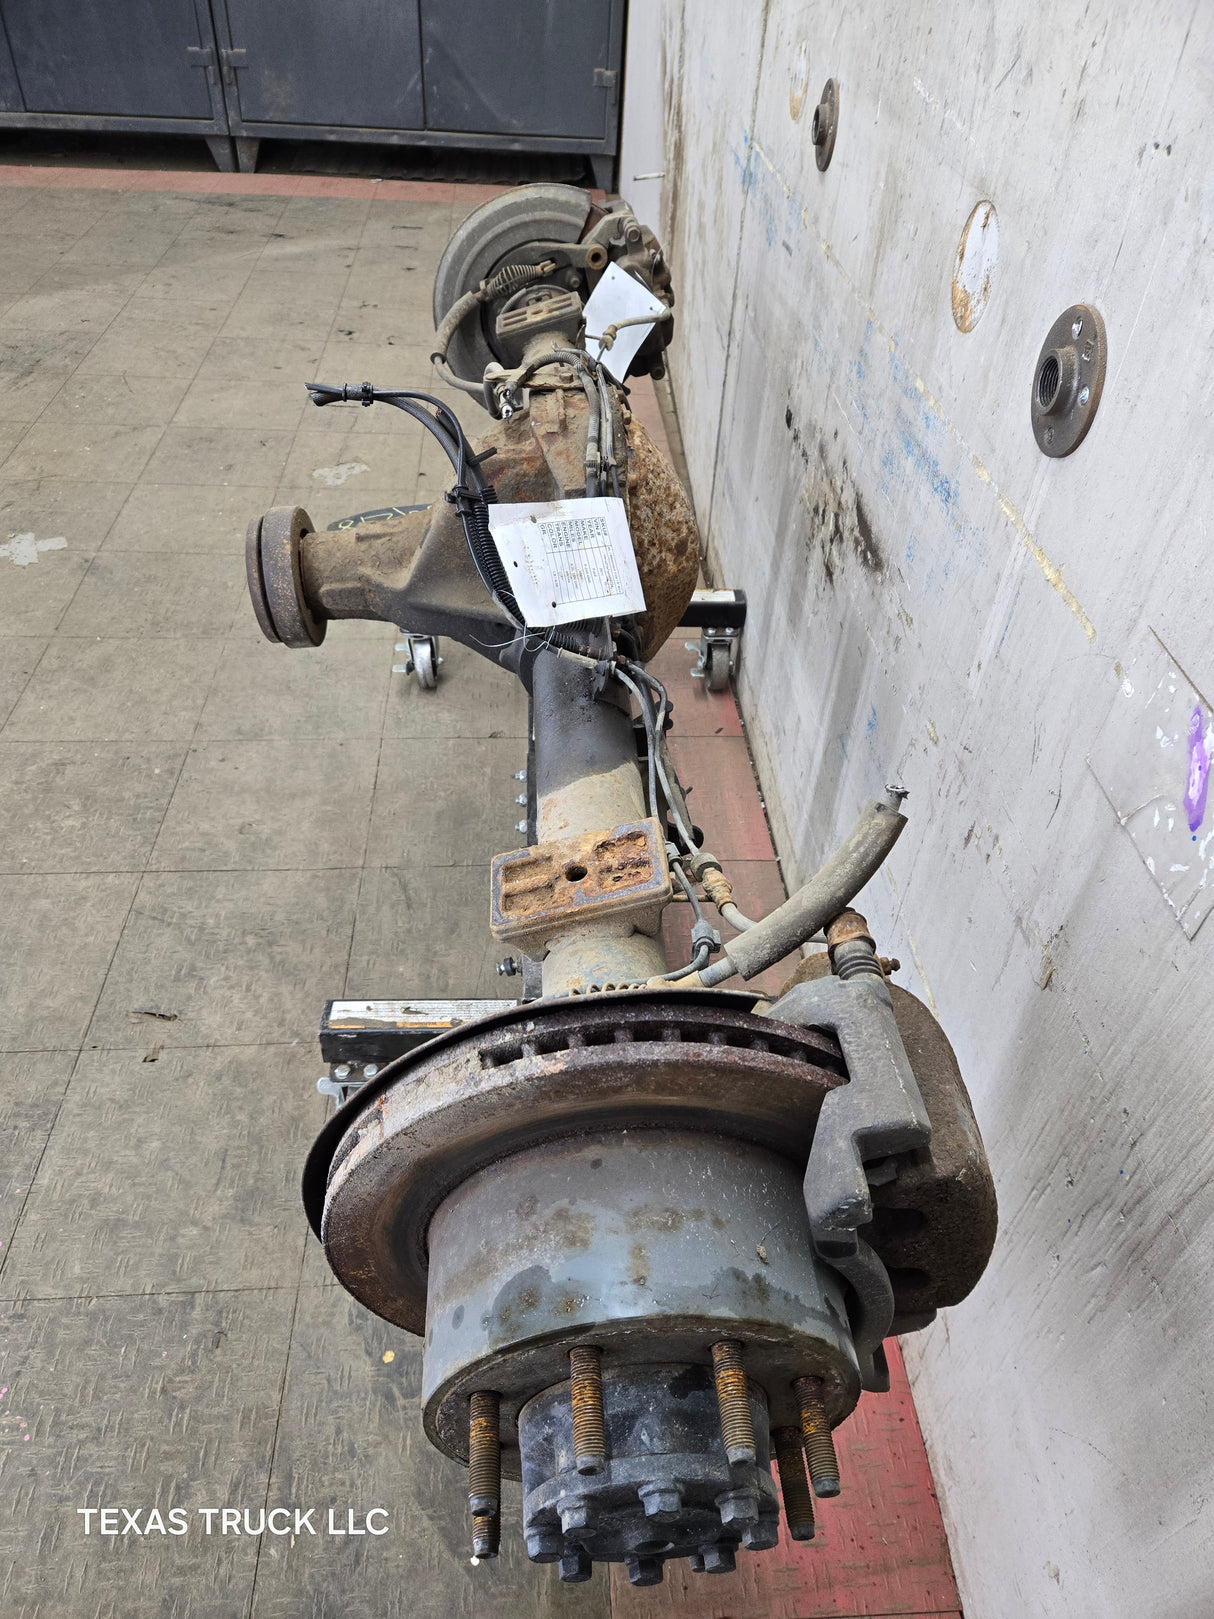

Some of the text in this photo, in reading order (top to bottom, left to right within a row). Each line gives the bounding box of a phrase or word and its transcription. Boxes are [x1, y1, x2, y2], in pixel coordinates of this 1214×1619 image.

[547, 523, 557, 548] COLOR
[554, 522, 564, 546] TRANS
[560, 522, 570, 548] ENGINE
[567, 521, 576, 542] MILES
[573, 520, 583, 545] MODEL
[580, 520, 588, 540] MAKE
[586, 519, 594, 538] YEAR
